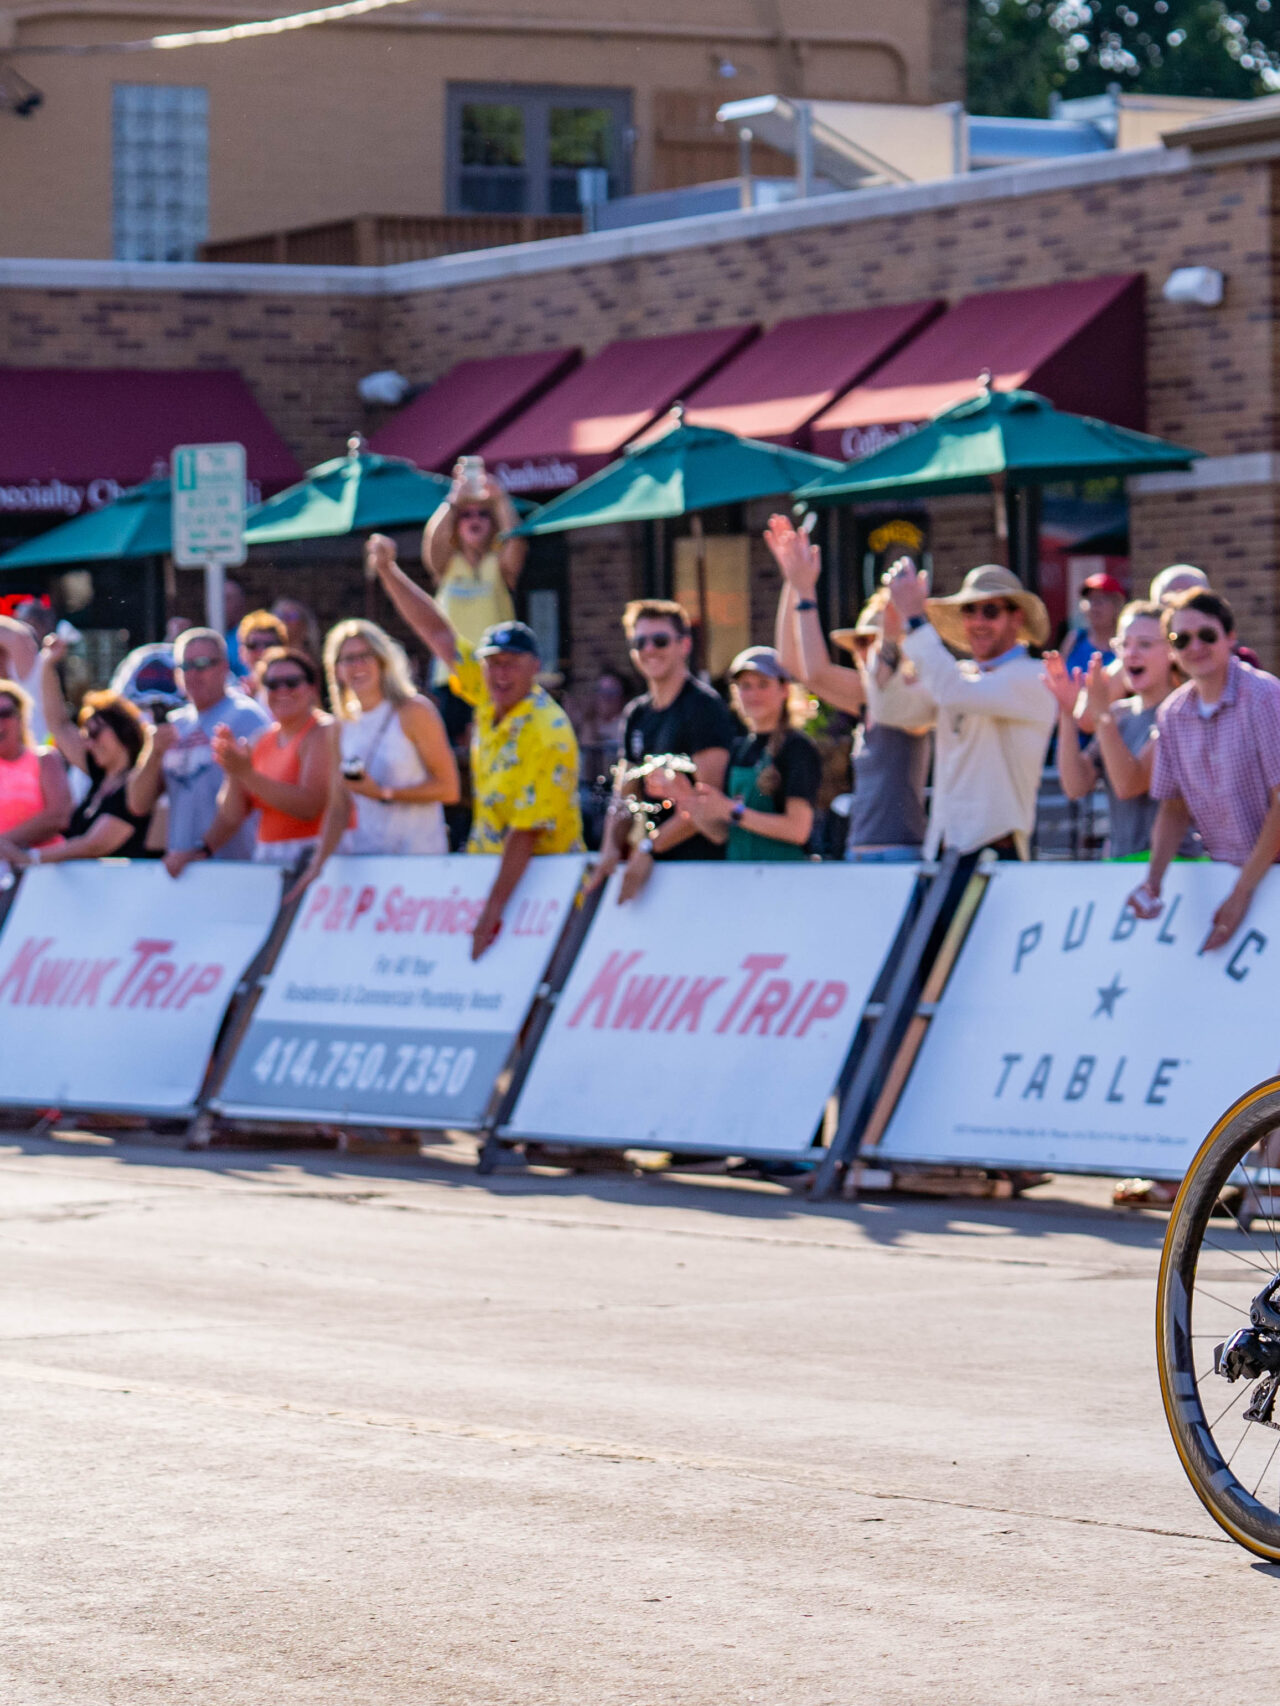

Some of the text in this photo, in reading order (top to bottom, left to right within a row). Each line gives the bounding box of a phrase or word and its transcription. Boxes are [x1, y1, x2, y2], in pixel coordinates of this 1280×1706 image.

[0, 478, 82, 516] pecialty
[302, 884, 560, 937] P&P Service LLC
[1012, 893, 1268, 983] PUBLC
[253, 1036, 477, 1097] 414.750.7350
[993, 1053, 1180, 1105] TABLE
